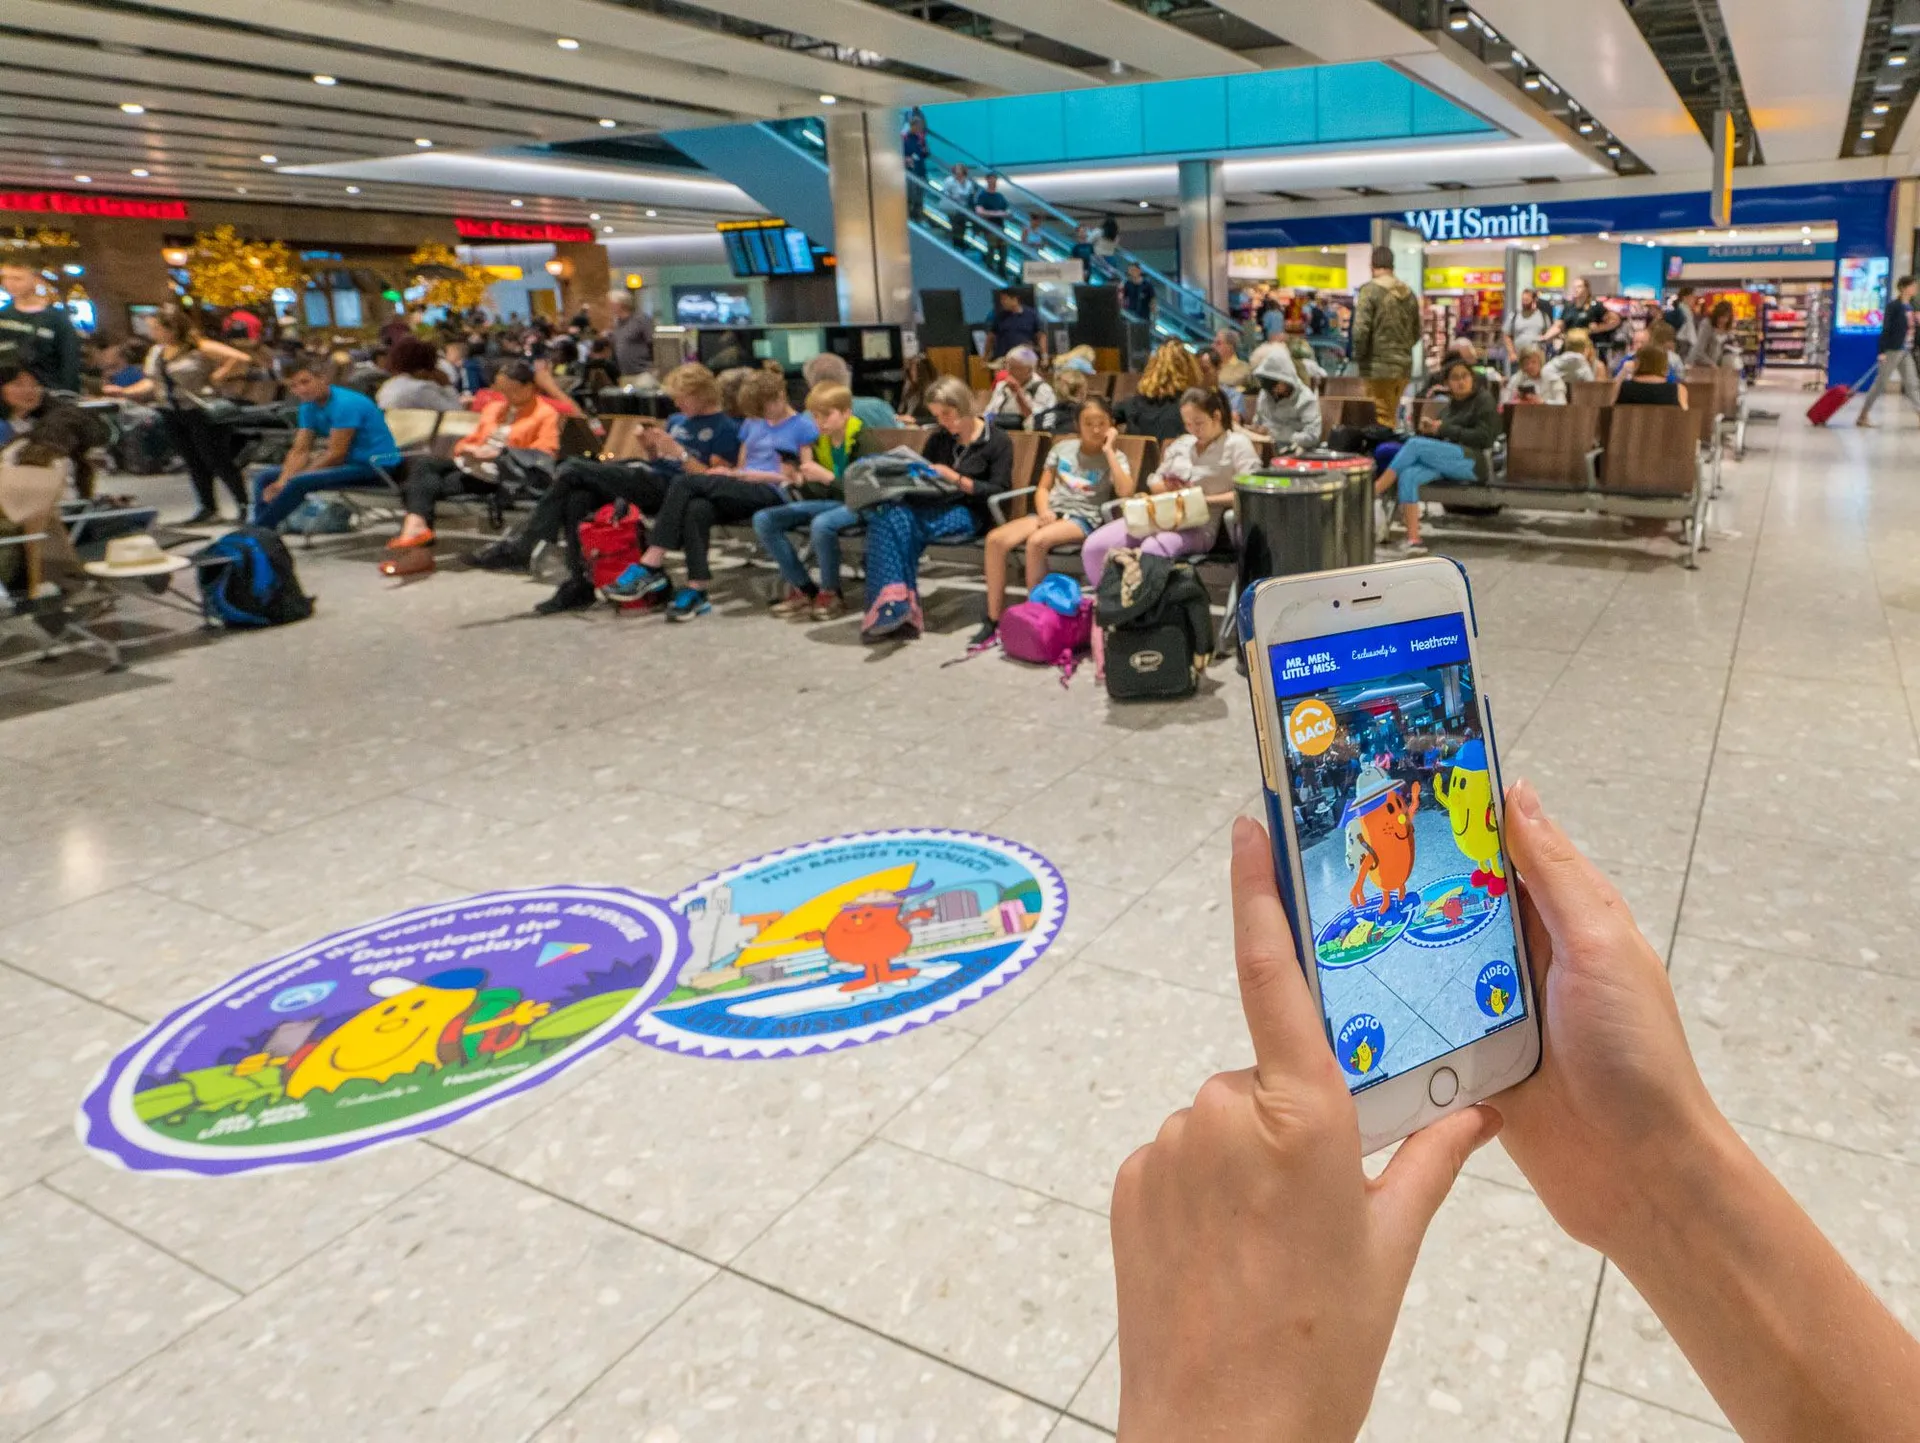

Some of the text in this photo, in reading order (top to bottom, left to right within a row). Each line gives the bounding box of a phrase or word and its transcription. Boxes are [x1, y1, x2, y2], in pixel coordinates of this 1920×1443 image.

[1404, 203, 1549, 240] WHSmith
[1351, 645, 1397, 660] Exclusively to
[1410, 634, 1458, 652] Heathrow
[1282, 667, 1310, 680] LITTLE
[1286, 658, 1305, 669] MR.
[1295, 717, 1335, 745] BACK
[376, 913, 456, 941] world
[462, 904, 515, 921] with
[350, 918, 563, 964] Download the
[351, 931, 543, 976] app to play!
[1479, 964, 1510, 985] VIDEO
[685, 1007, 760, 1038] LITTLE
[770, 1012, 850, 1035] MISS
[1340, 1016, 1380, 1043] PHOTO
